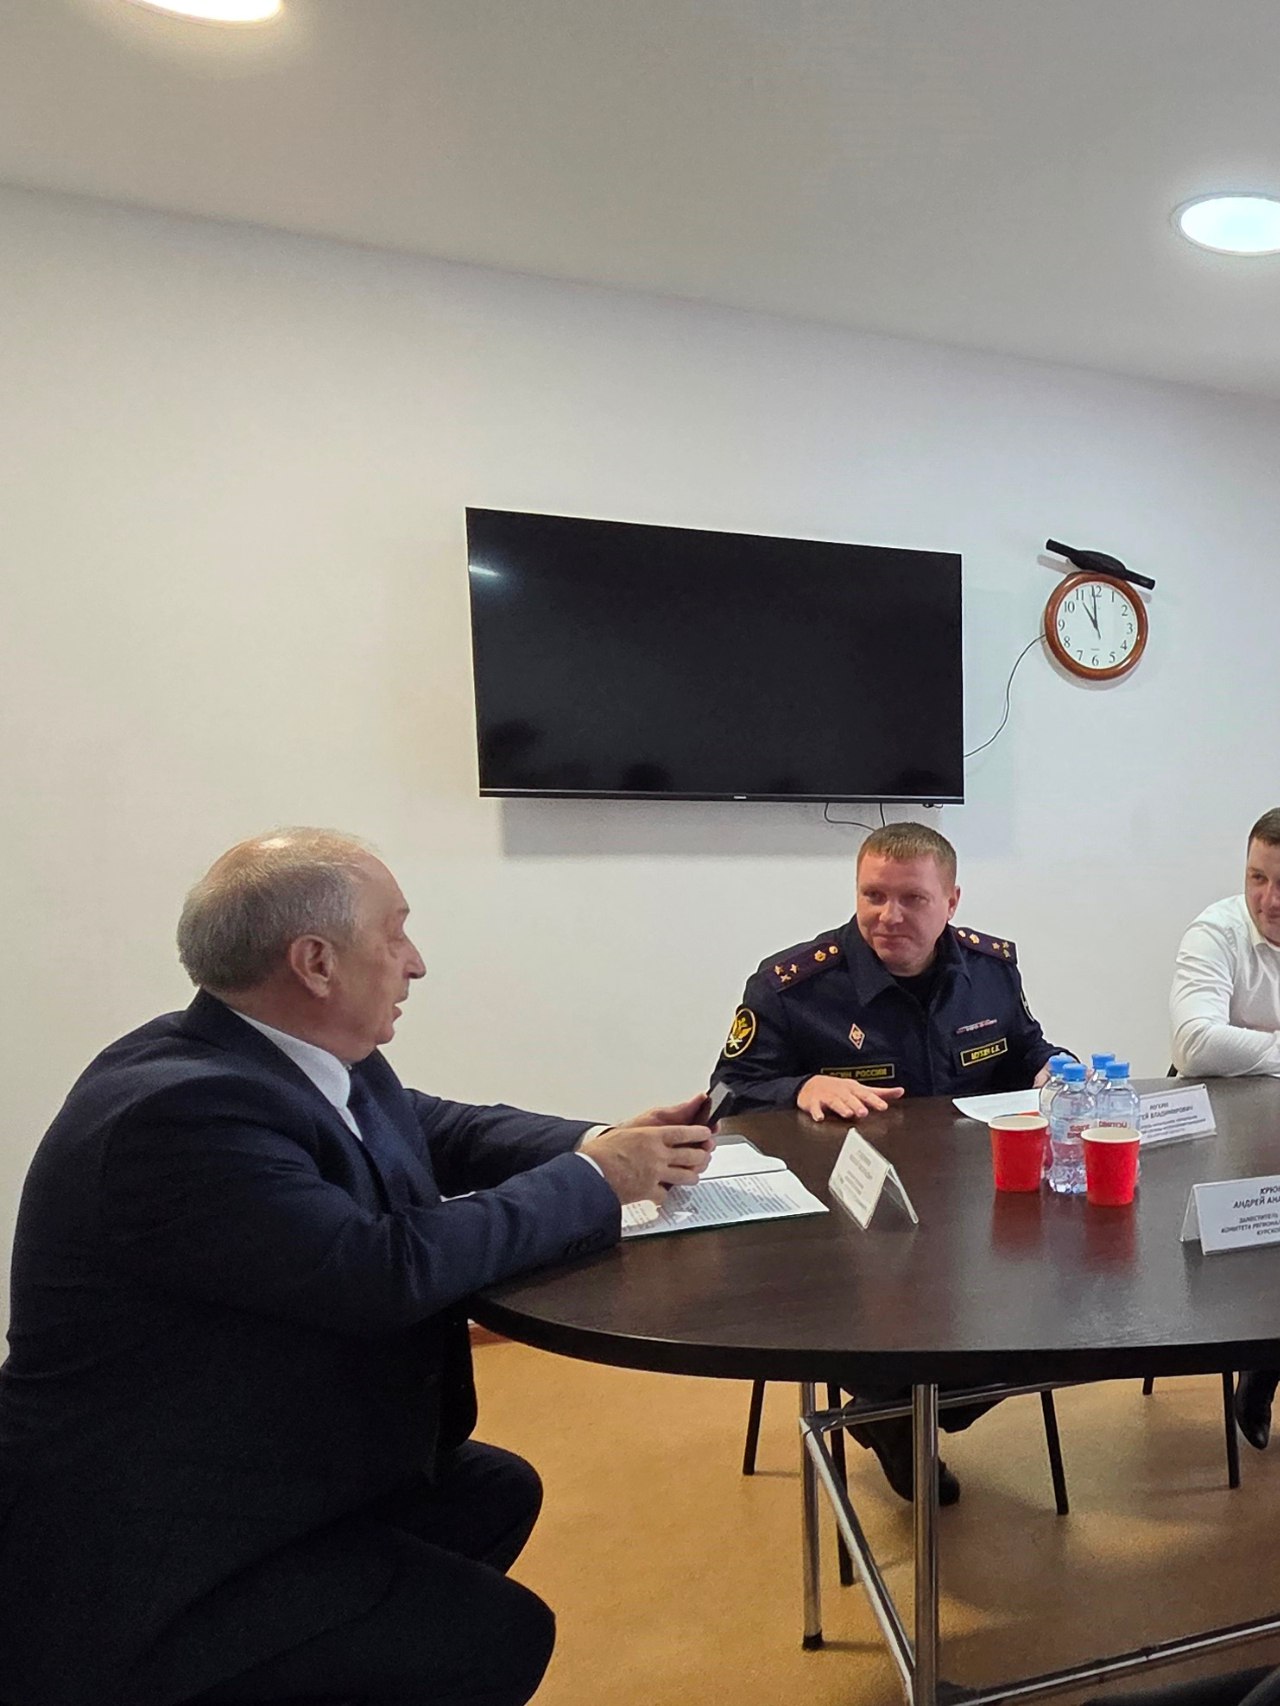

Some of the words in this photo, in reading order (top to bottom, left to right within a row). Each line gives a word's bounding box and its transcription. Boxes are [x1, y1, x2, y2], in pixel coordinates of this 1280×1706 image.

[1076, 588, 1084, 601] 11
[1064, 601, 1075, 613] 10
[1121, 604, 1128, 617] 2
[1058, 619, 1065, 631] 9
[1126, 622, 1133, 635] 3
[1063, 636, 1071, 648] 8
[1120, 639, 1127, 651] 4
[1076, 650, 1083, 661] 7
[1091, 654, 1099, 666] 6
[1109, 651, 1116, 663] 5
[855, 1068, 887, 1078] РОССИИ
[1233, 1196, 1265, 1209] АНДРЕЙ
[1220, 1224, 1252, 1234] КОМИТЕТА
